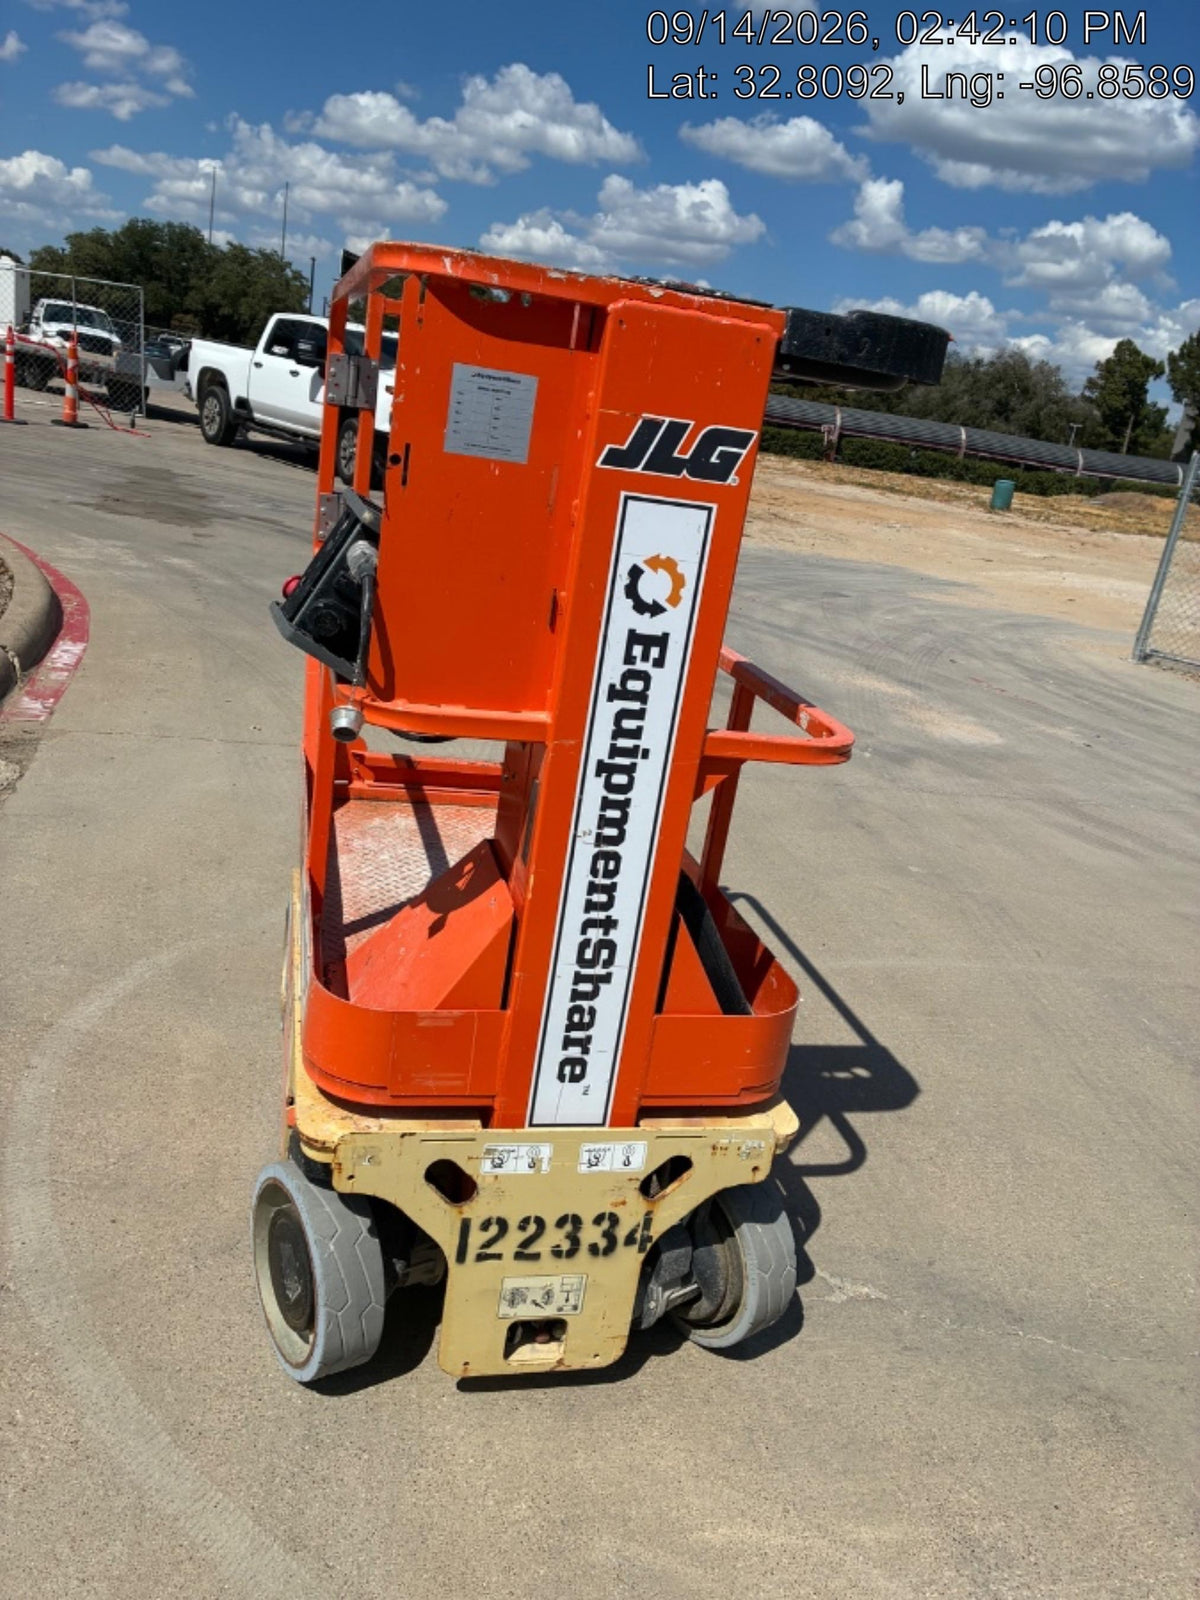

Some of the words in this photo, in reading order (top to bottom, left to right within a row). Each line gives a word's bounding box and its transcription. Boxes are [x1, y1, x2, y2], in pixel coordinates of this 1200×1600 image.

[596, 413, 758, 485] JLG
[556, 628, 670, 1084] EquipmentShare
[455, 1210, 654, 1265] 122334
